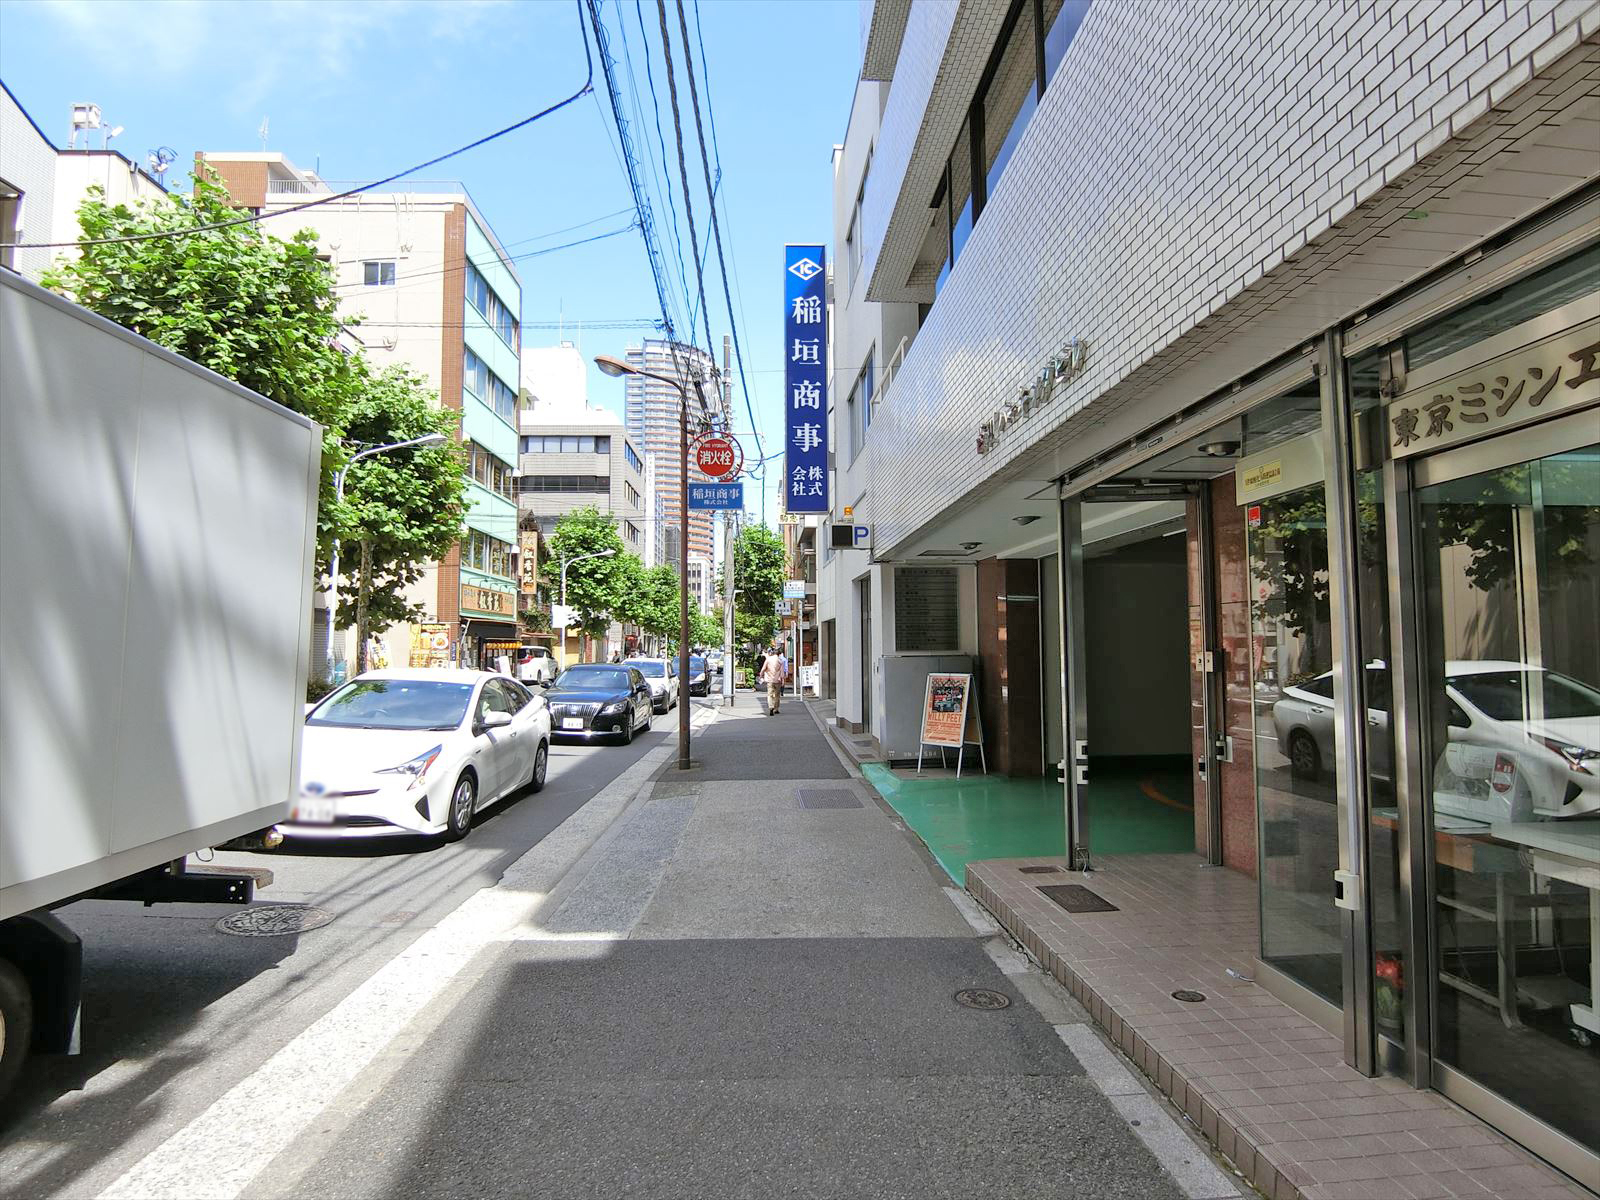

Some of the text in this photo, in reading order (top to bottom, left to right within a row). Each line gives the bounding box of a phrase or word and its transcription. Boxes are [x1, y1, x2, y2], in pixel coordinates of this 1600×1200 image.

[791, 295, 822, 453] 稲垣商事
[700, 450, 731, 465] 消火栓
[692, 488, 740, 499] 稲垣商事
[854, 526, 869, 545] P
